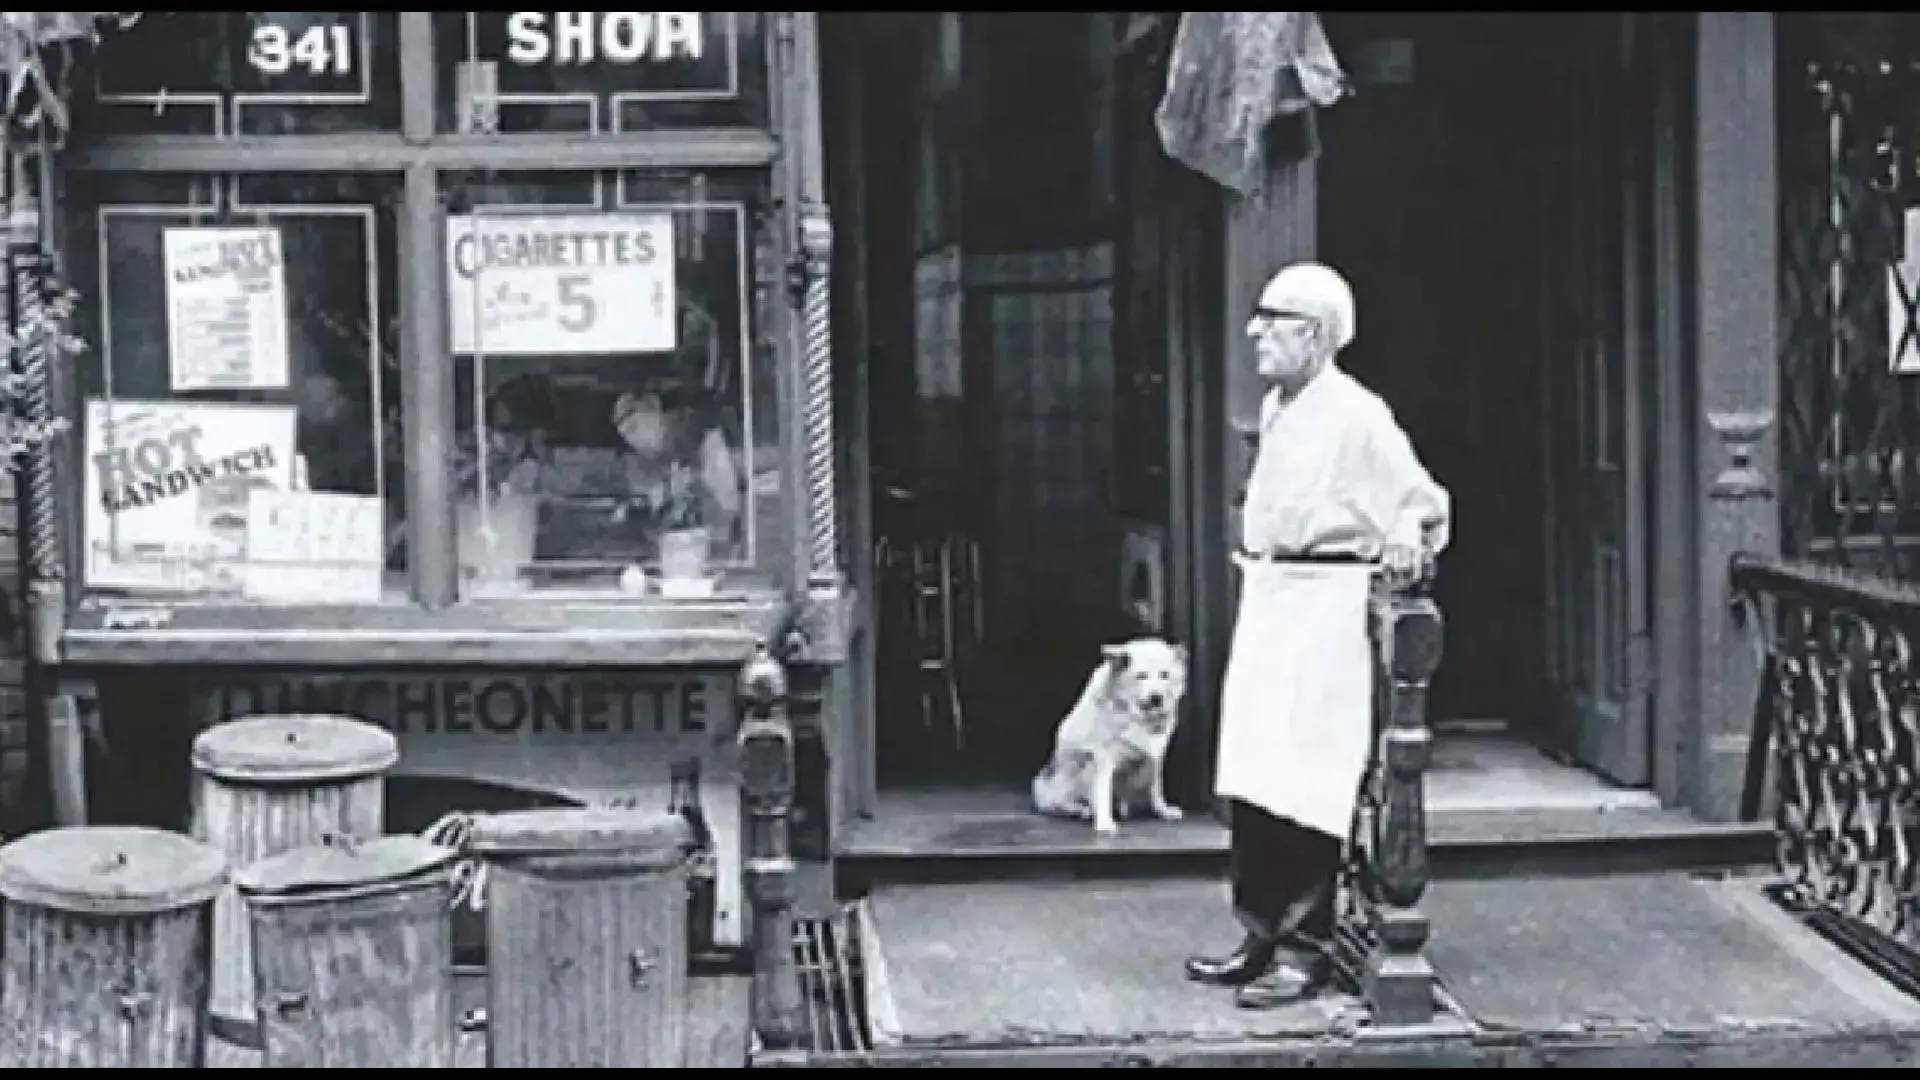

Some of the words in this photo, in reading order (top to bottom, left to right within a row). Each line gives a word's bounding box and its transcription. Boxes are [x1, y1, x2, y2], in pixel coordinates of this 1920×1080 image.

[248, 25, 351, 74] 341
[454, 231, 656, 278] CIGARETTES
[556, 274, 597, 332] 5
[93, 424, 202, 488] HOT
